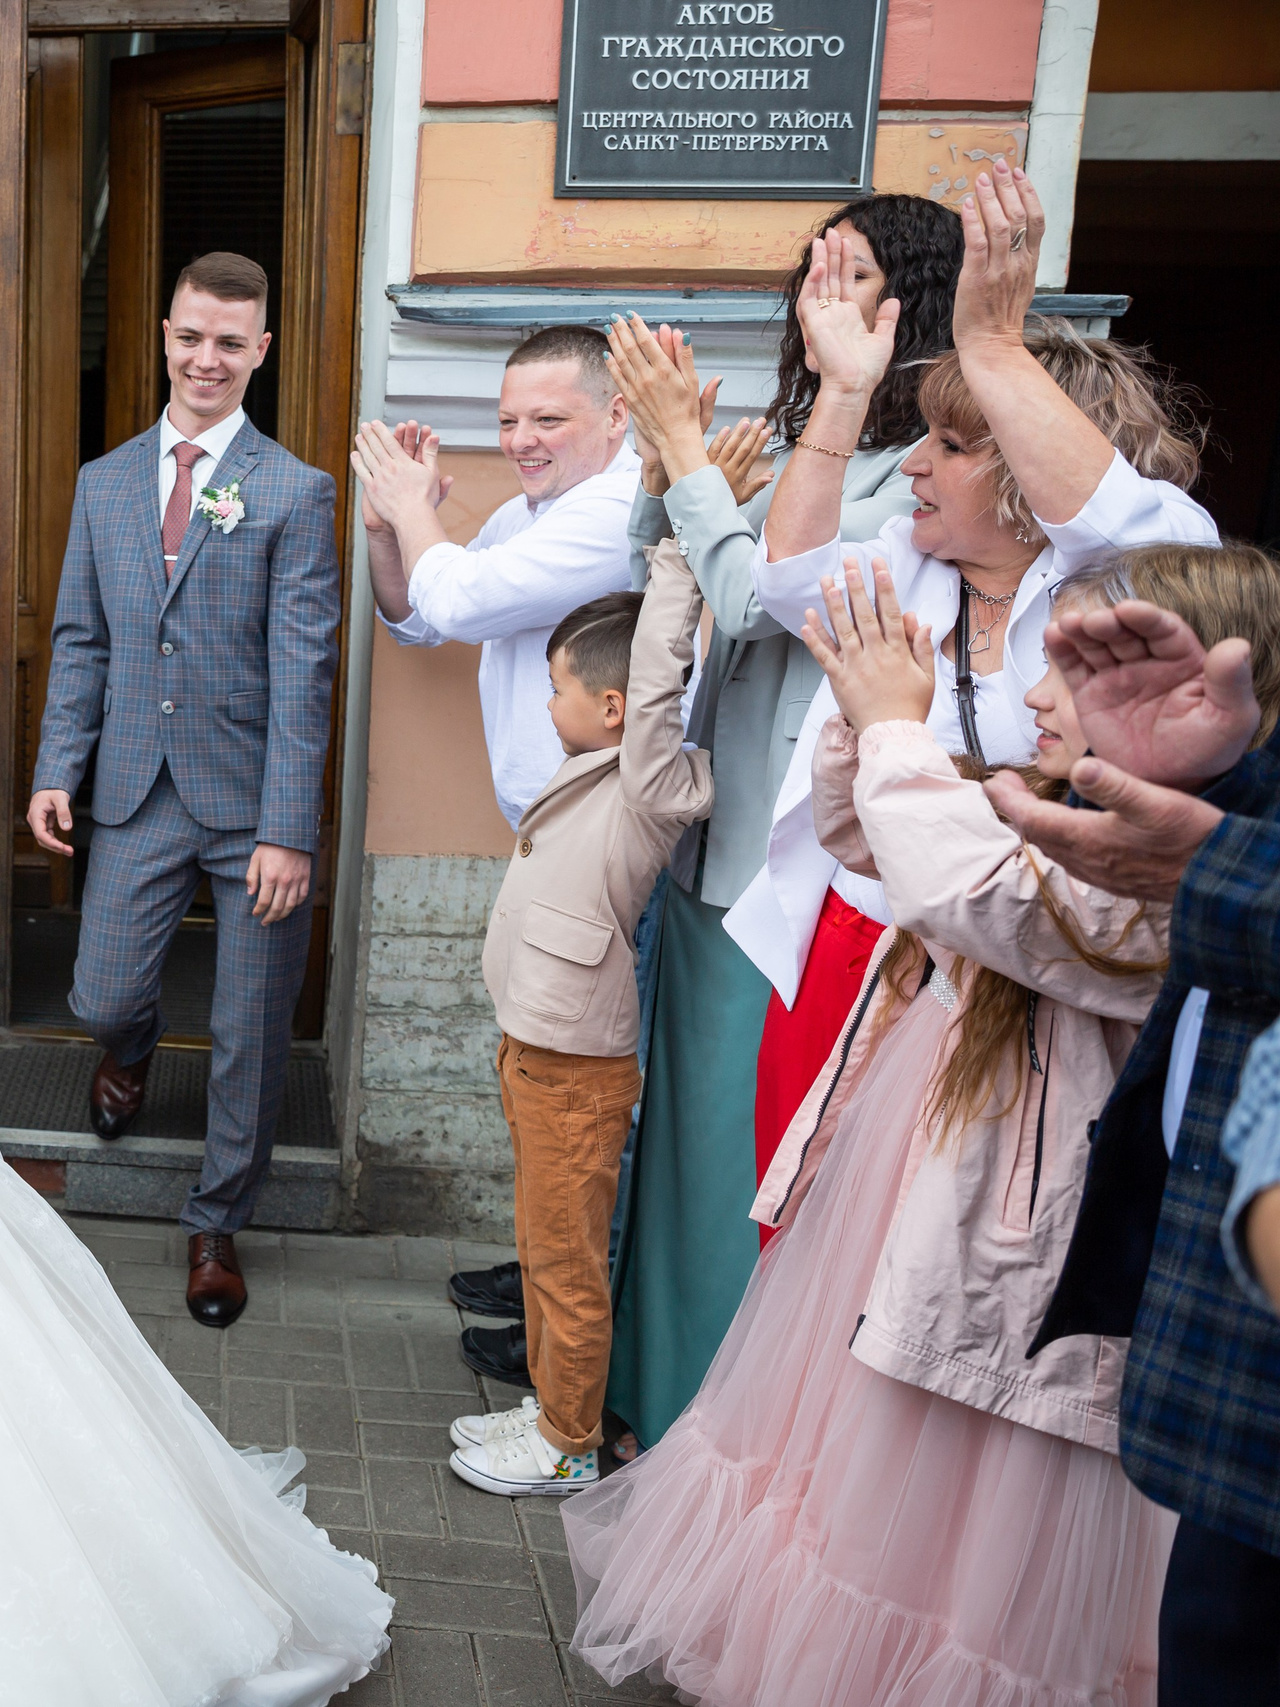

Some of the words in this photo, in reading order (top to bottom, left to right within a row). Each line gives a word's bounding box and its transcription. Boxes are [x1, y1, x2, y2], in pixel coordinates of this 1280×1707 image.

[676, 3, 774, 26] АКТОВ
[601, 36, 845, 61] ГРАЖДАНСКОГО
[632, 69, 810, 91] СОСТОЯНИЯ
[582, 112, 757, 131] ЦЕНТРАЛЬНОГО
[768, 110, 854, 129] РАЙОНА
